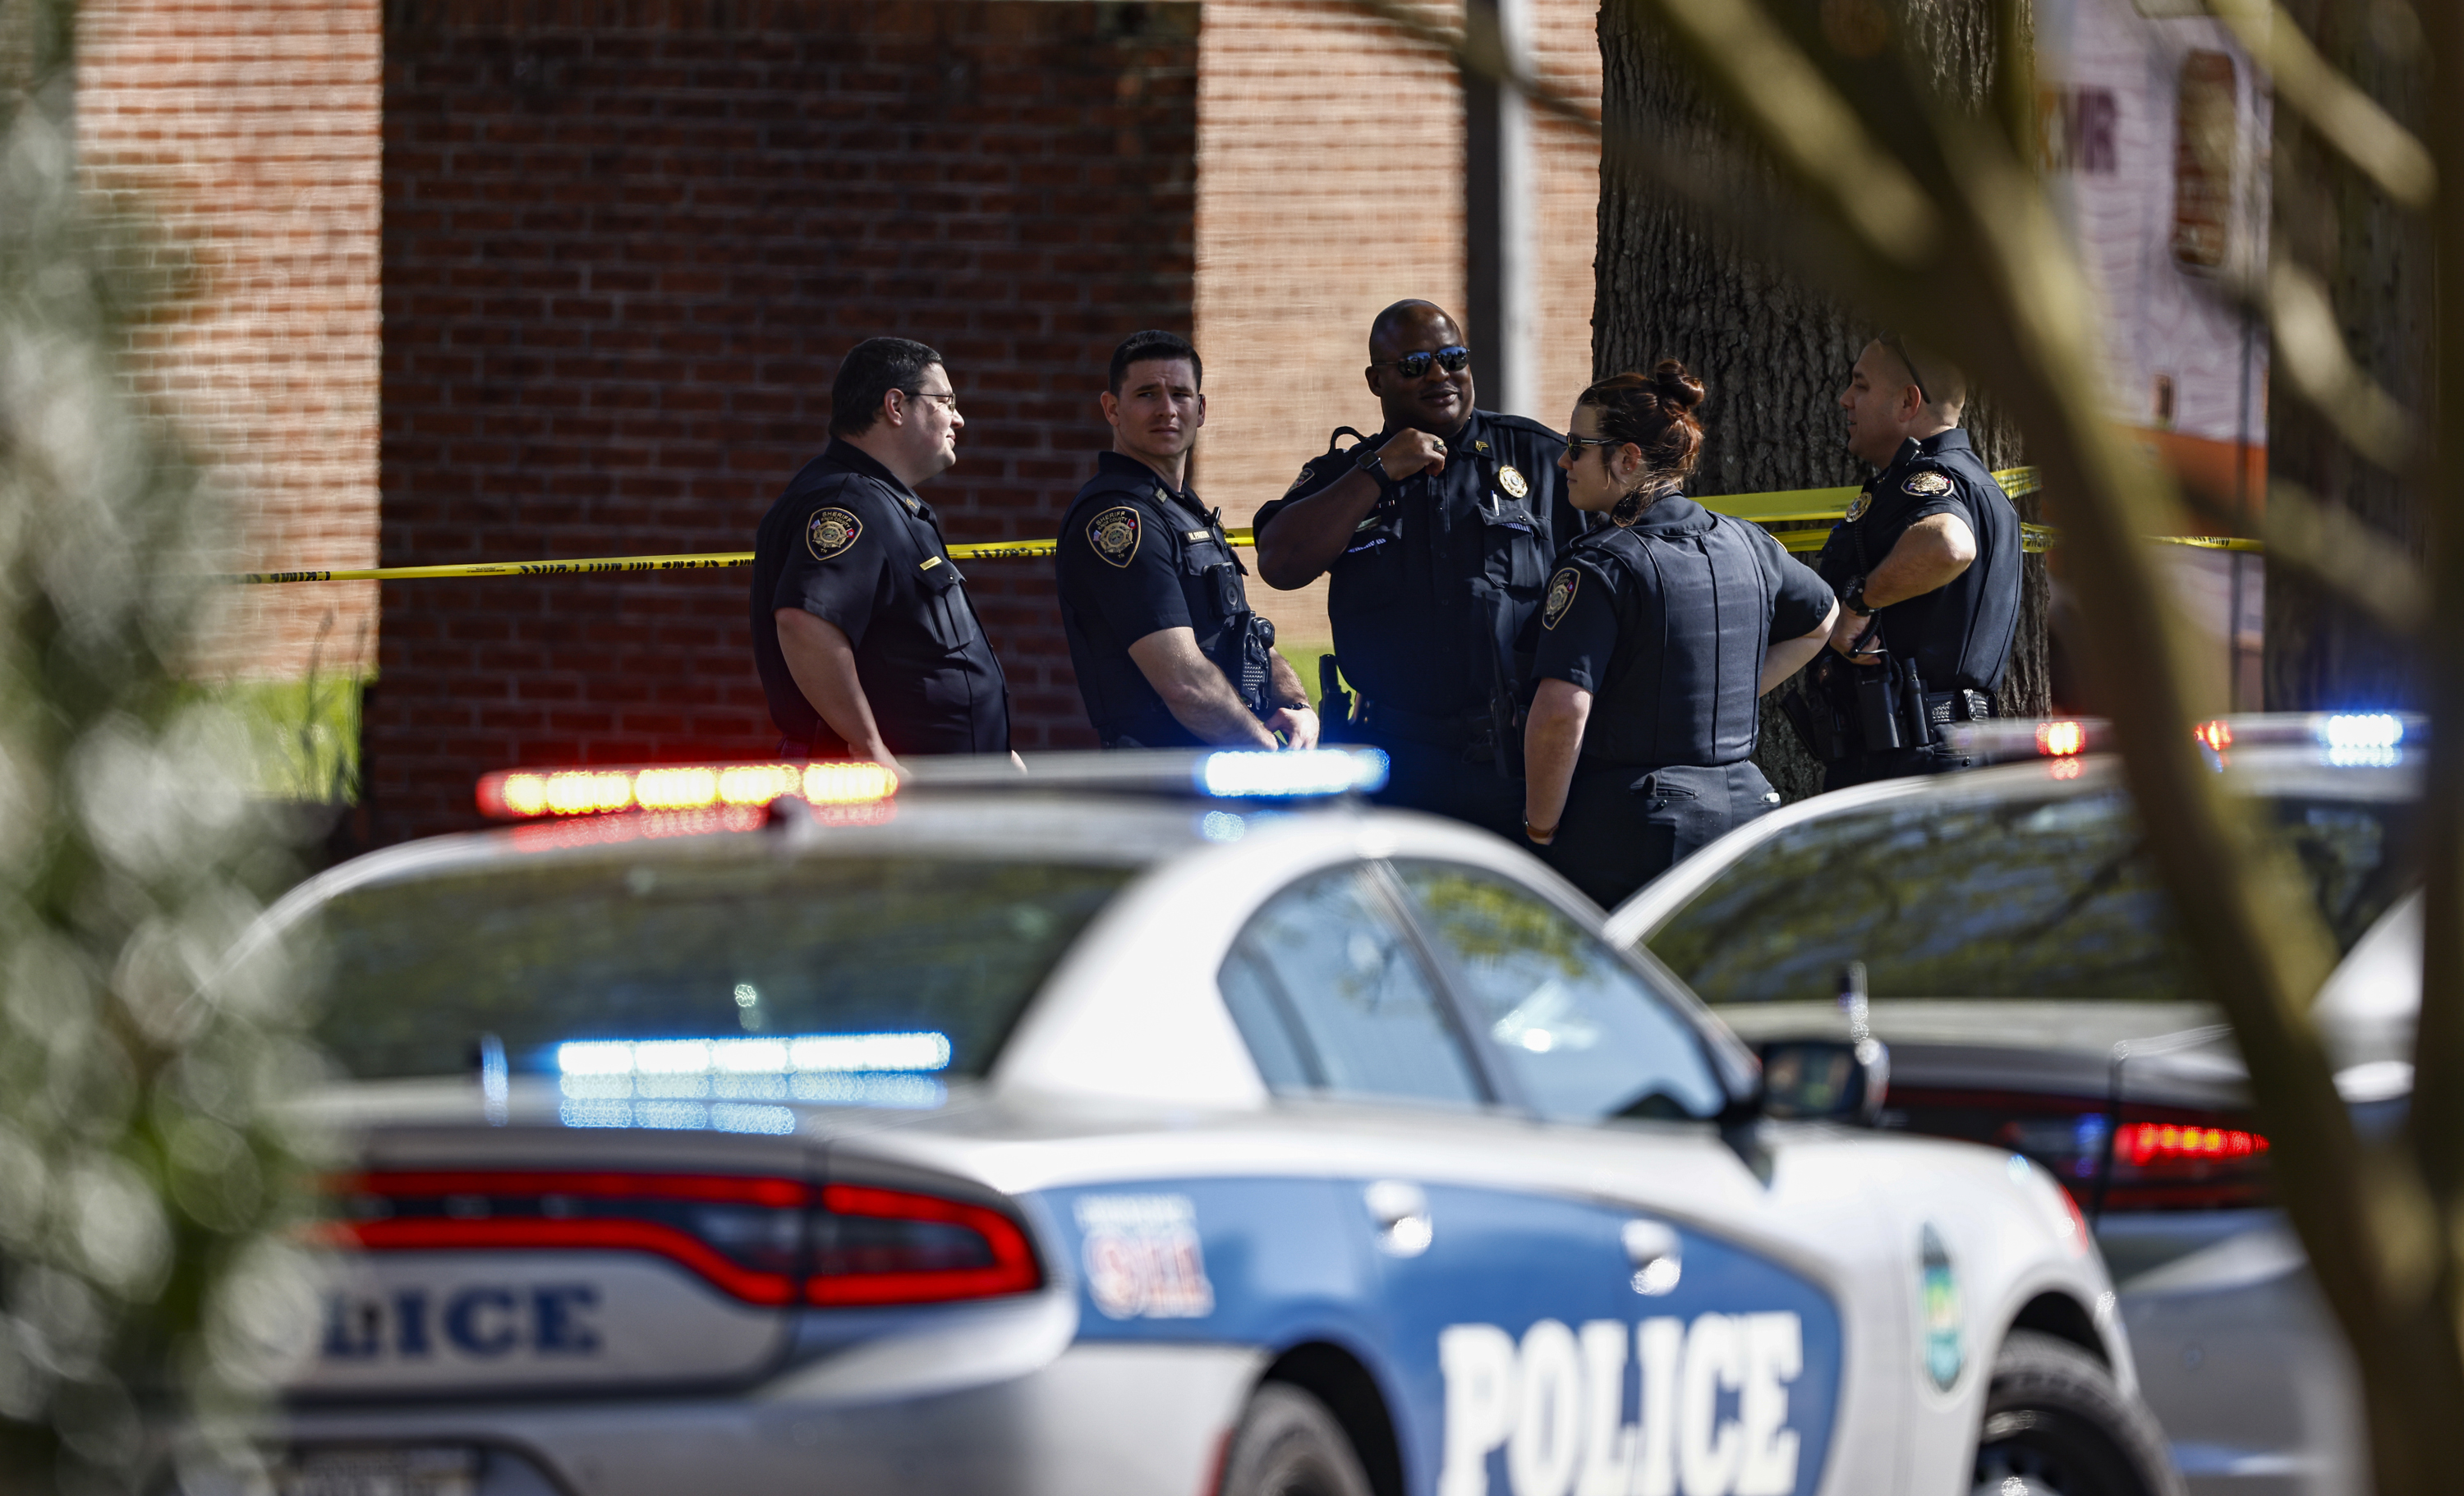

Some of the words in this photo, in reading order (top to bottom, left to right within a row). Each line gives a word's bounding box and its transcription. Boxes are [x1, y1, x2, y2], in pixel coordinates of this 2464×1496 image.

[822, 511, 853, 522] SHERIFF
[1096, 511, 1126, 525] SHERIFF
[323, 1281, 606, 1358] LICE
[1436, 1310, 1804, 1496] POLICE
